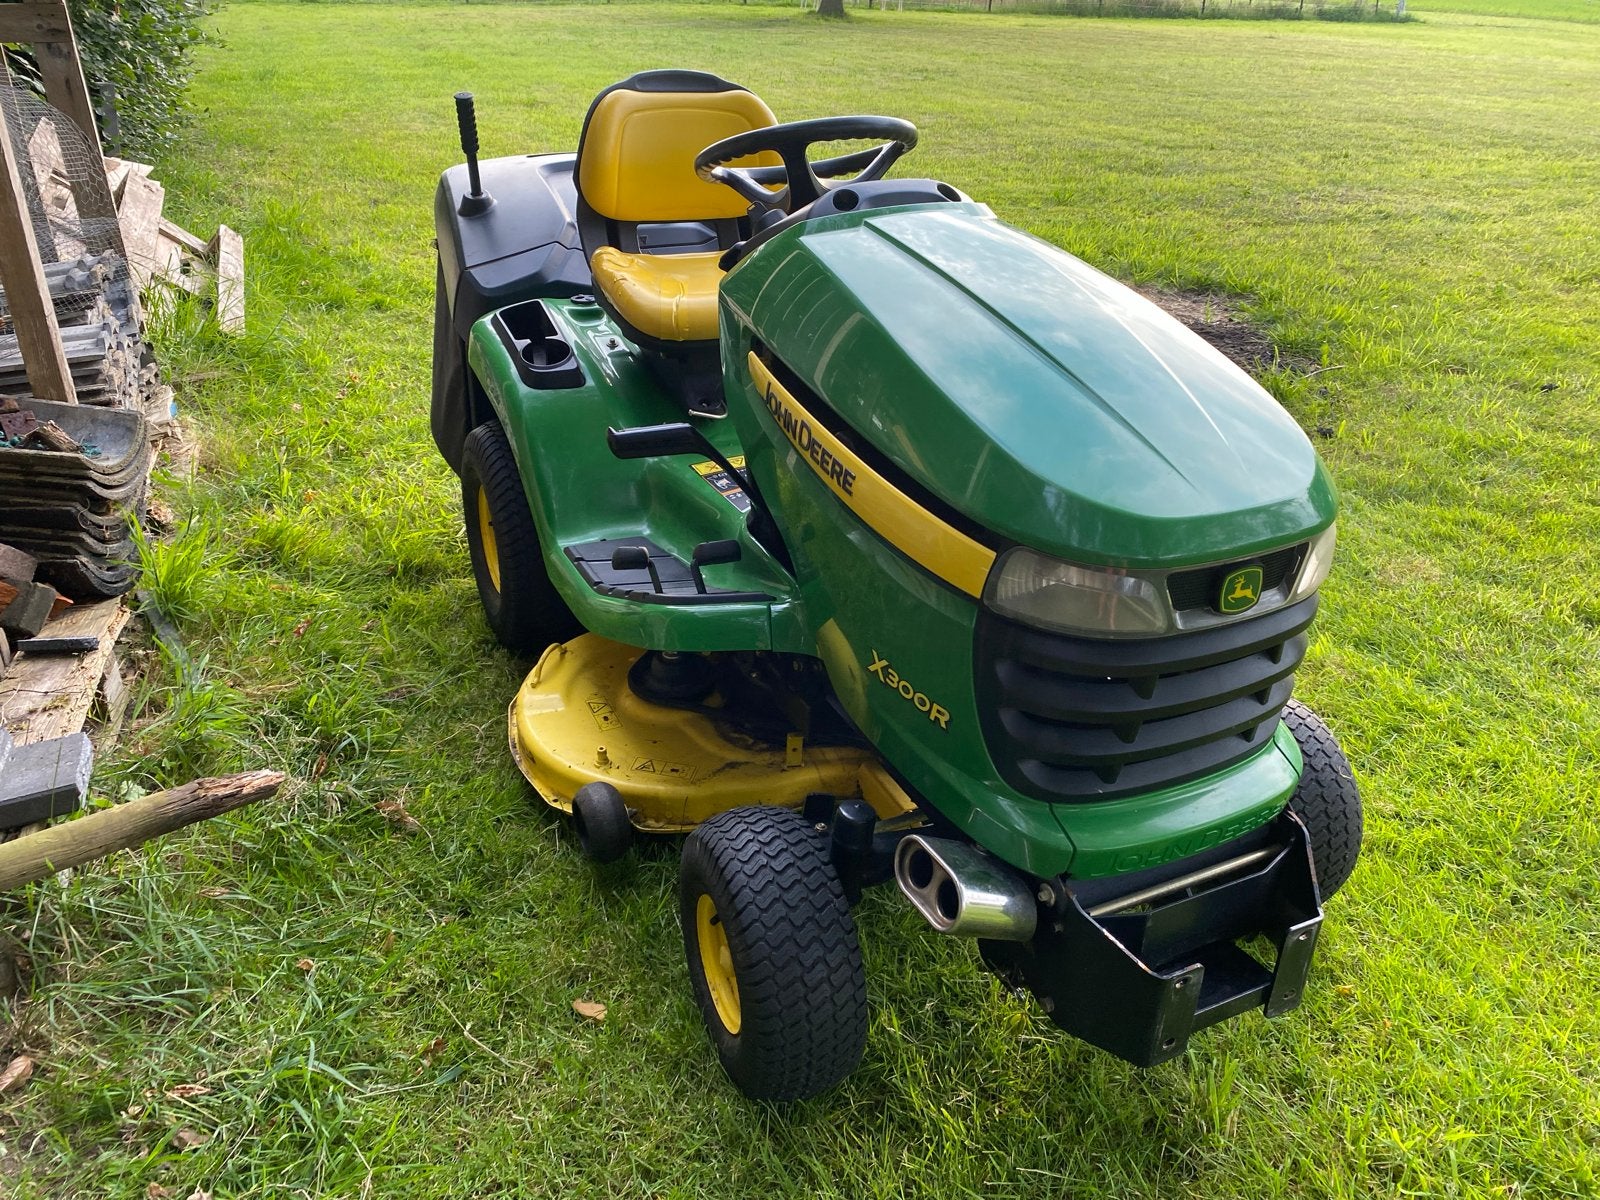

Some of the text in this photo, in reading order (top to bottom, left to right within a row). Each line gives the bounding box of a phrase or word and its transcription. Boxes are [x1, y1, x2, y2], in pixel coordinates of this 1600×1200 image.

[765, 381, 856, 497] JOHN DEERE
[866, 648, 950, 730] X300R
[1090, 840, 1193, 876] JOHN
